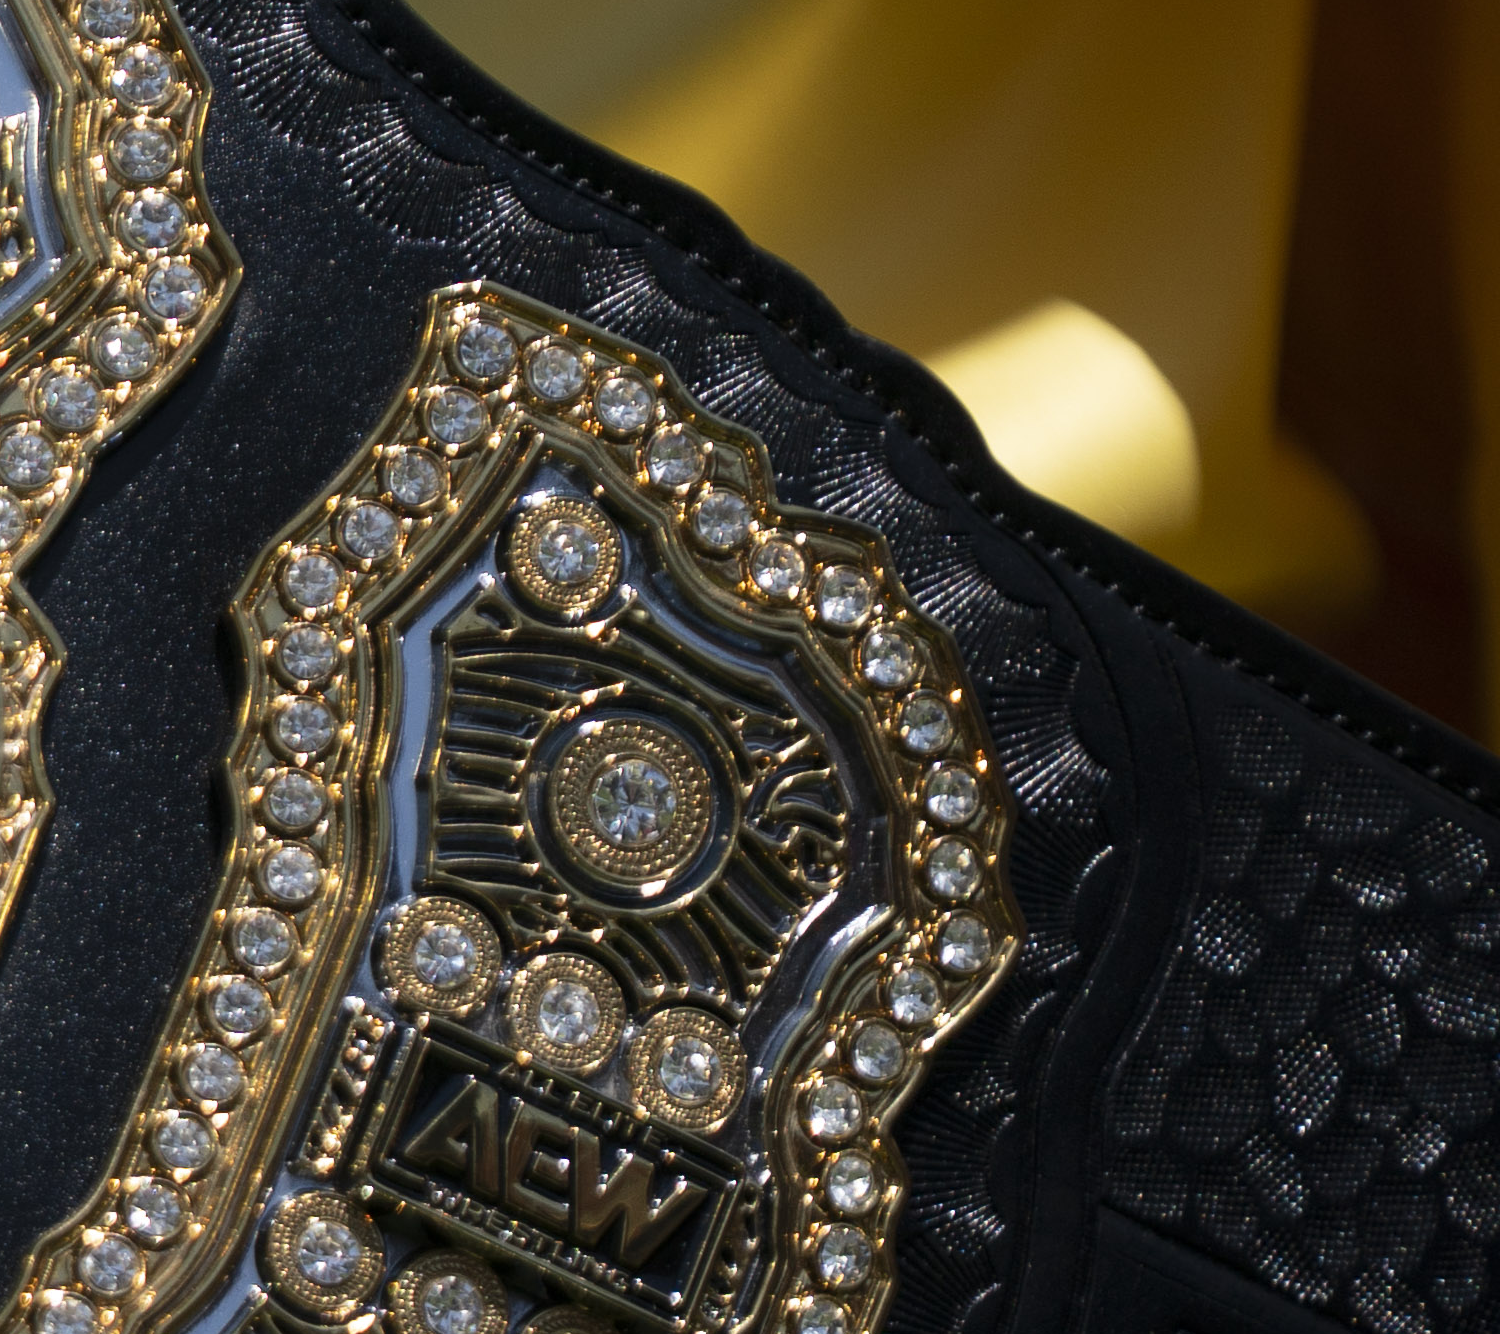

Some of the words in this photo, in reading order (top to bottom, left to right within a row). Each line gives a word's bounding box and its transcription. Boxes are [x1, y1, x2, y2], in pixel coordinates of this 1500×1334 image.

[402, 1073, 710, 1267] AEW
[564, 1088, 672, 1153] ELITE
[425, 1174, 633, 1292] WRESTLING
